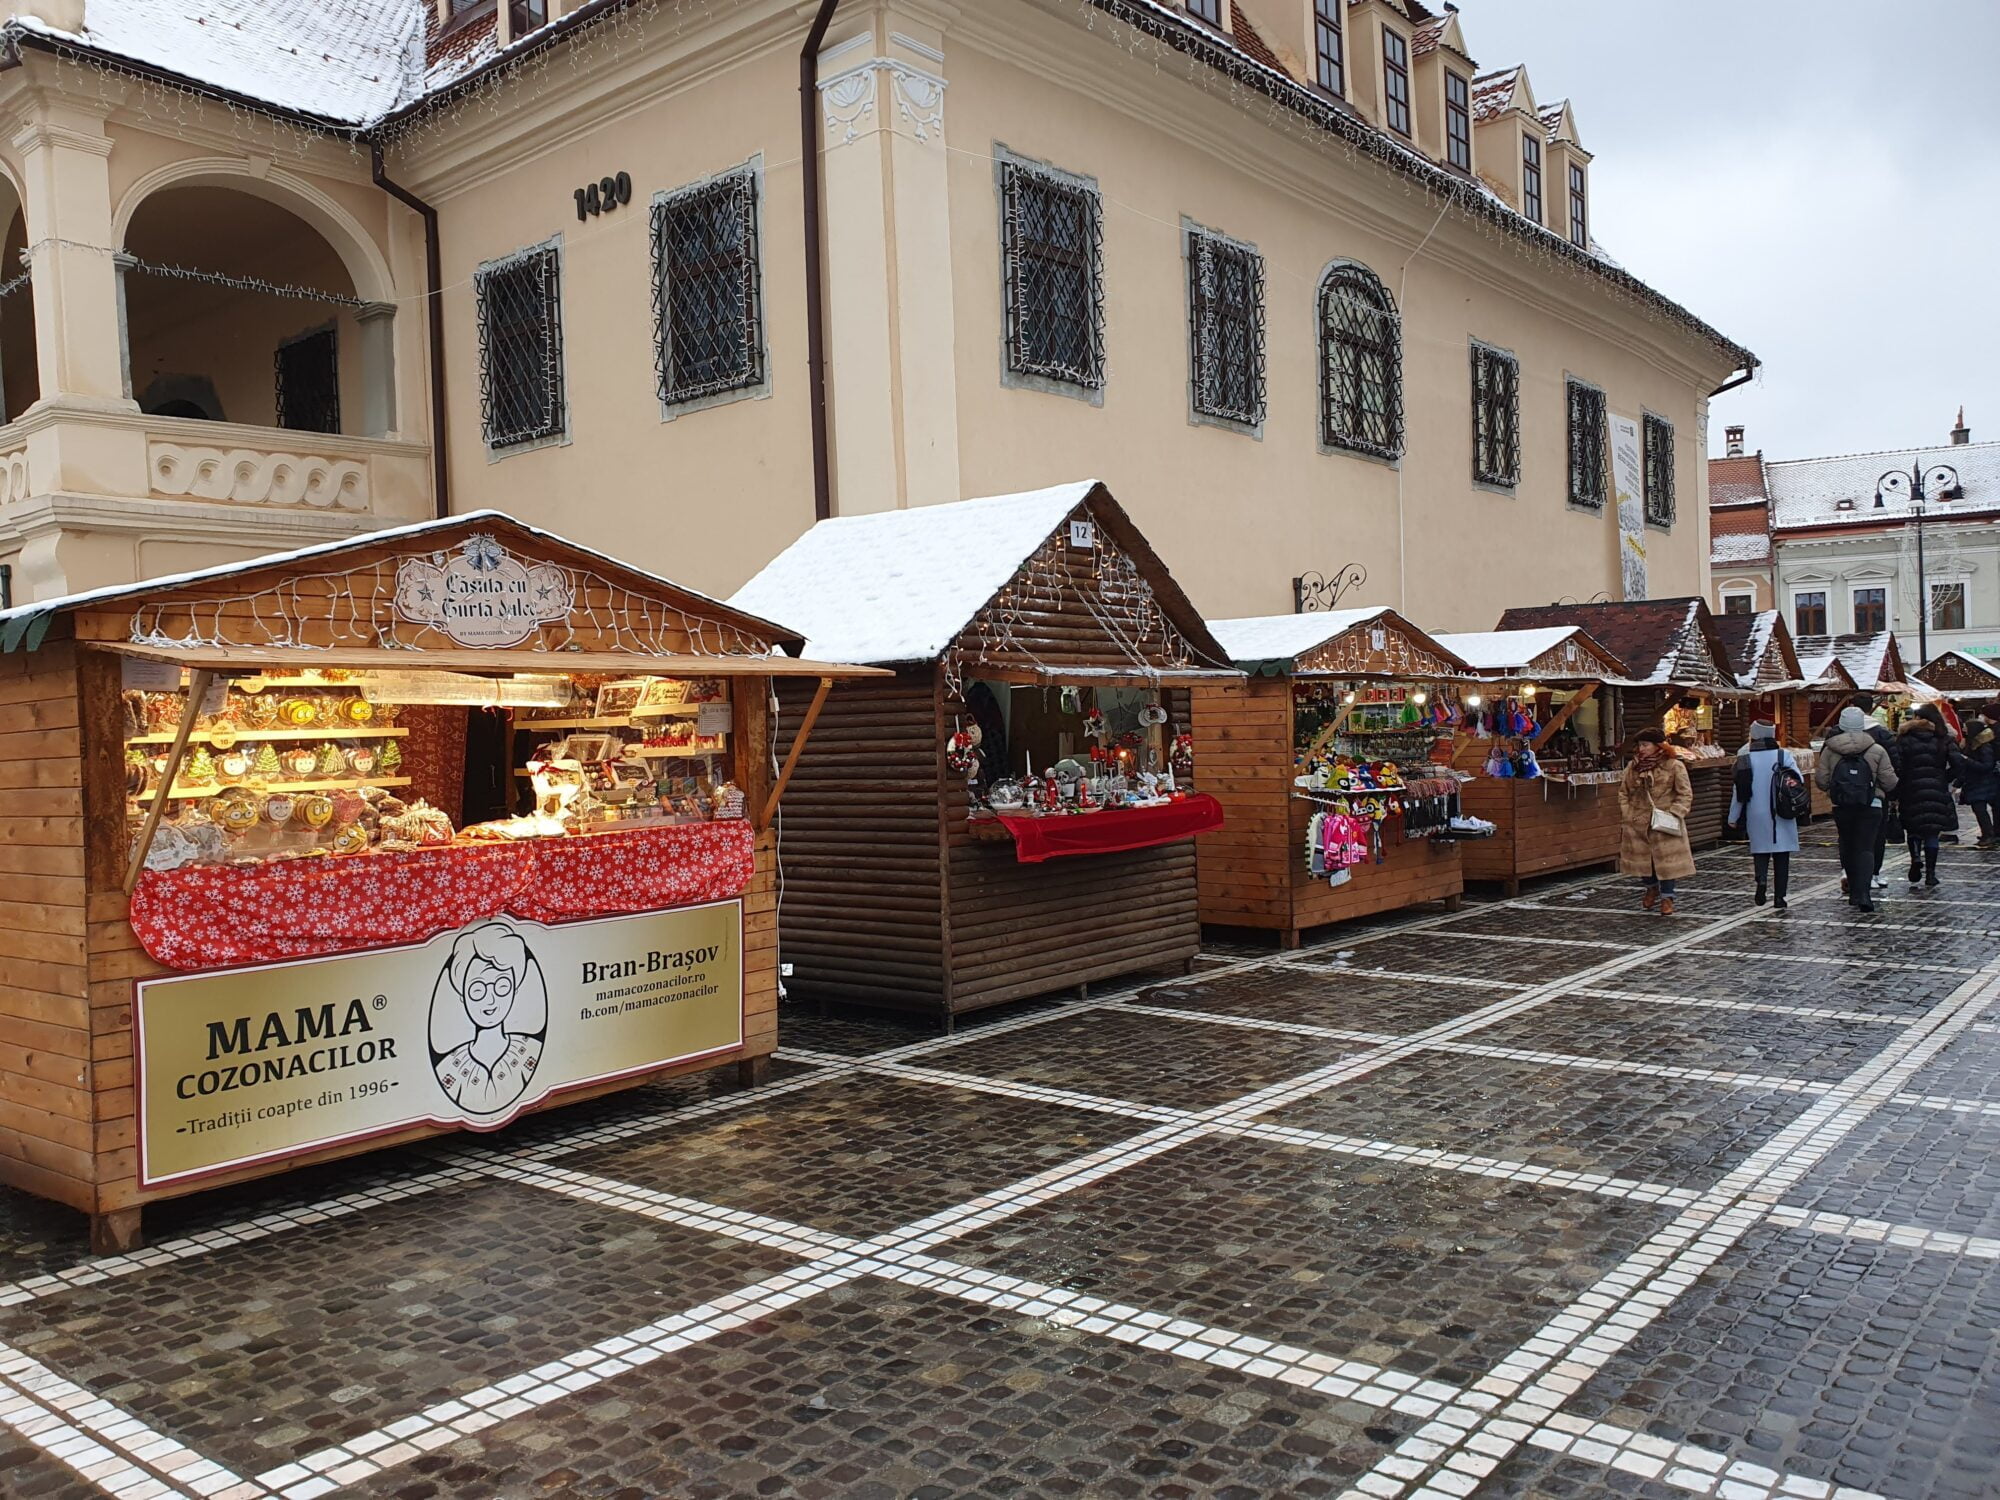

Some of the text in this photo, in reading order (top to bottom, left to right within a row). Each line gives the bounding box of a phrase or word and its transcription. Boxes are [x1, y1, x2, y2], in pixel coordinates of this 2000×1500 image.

[574, 171, 632, 221] 1420
[1075, 526, 1088, 539] 12
[582, 945, 719, 984] Bran-Brașov
[580, 984, 719, 1020] fb.com/mamacozonacilor
[596, 973, 706, 1001] mamacozonacilor.ro
[176, 1037, 397, 1100] COZONACILOR
[257, 1098, 313, 1118] coapte
[318, 1091, 343, 1107] din
